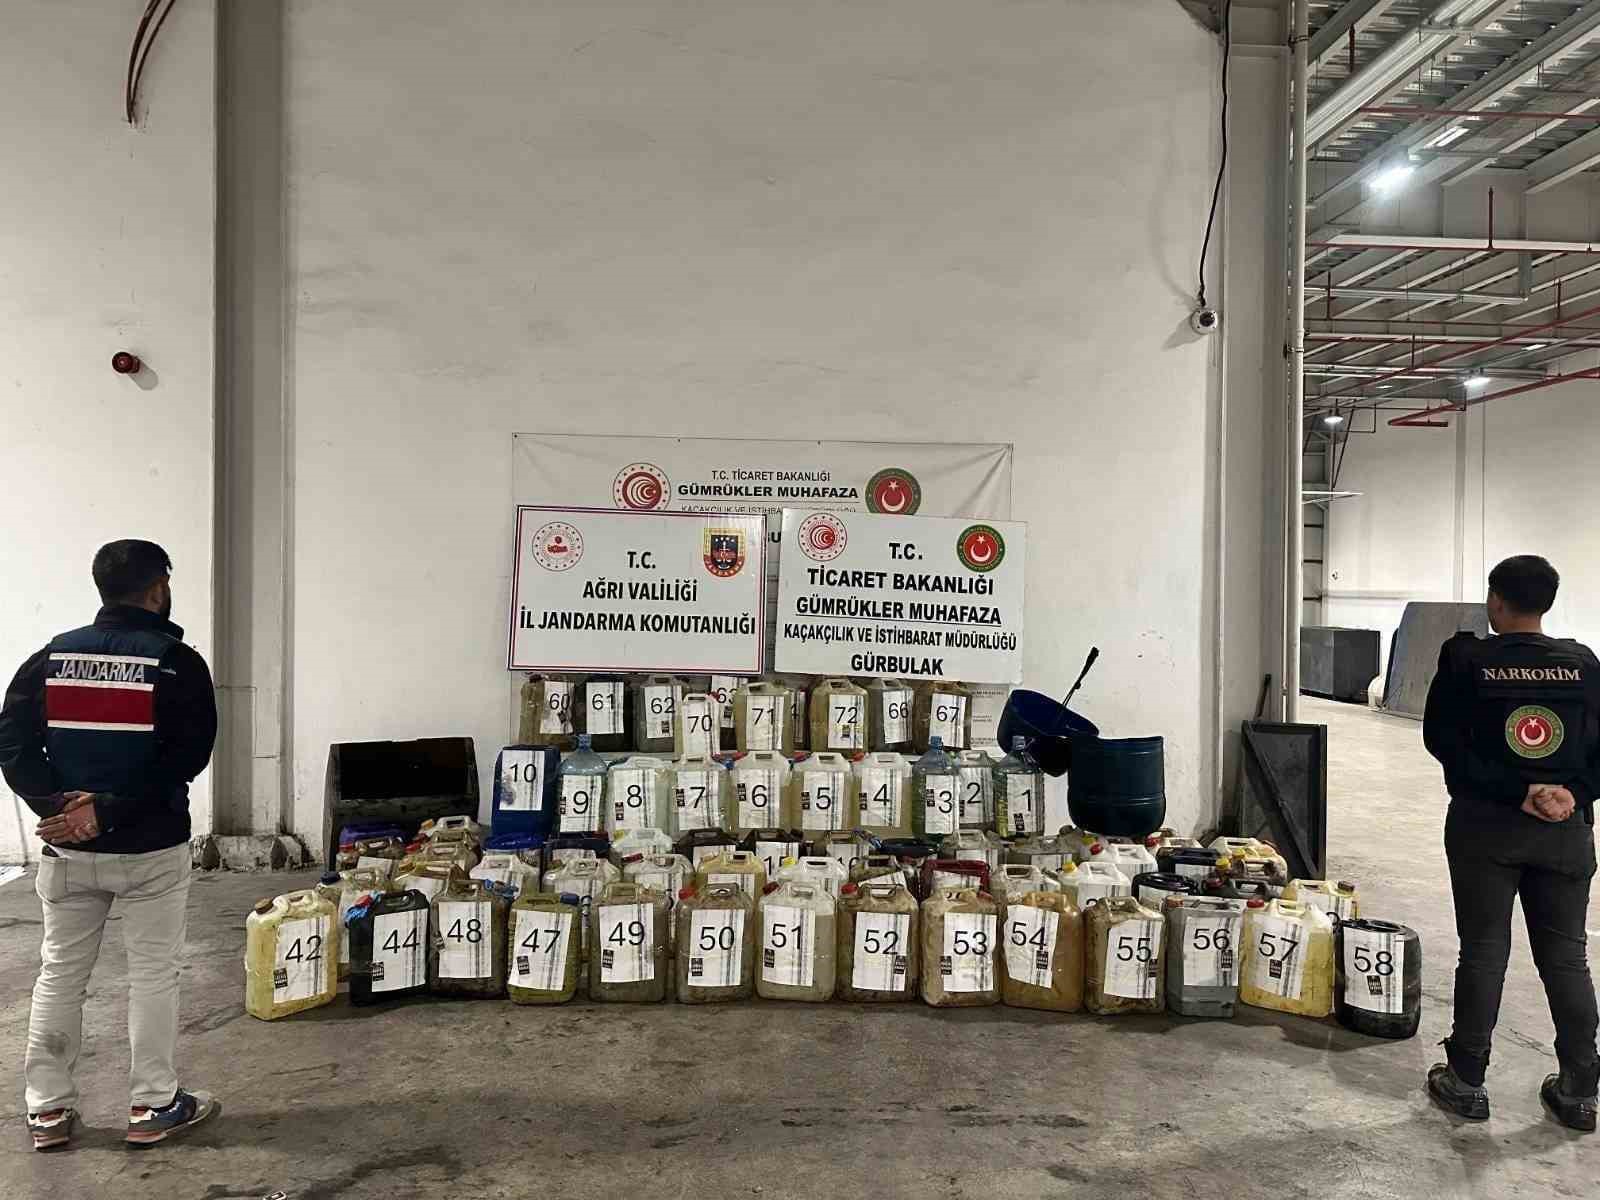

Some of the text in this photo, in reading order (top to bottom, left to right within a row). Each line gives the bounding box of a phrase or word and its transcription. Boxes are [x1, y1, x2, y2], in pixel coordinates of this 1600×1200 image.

[711, 468, 831, 483] T.C. TİCARET BAKANLIĞI
[678, 482, 858, 499] GÜMRÜKLER MUHAFAZA
[627, 551, 656, 569] T.C.
[889, 542, 923, 560] T.C.
[583, 577, 697, 602] AĞRI VALİLİĞİ
[808, 565, 993, 595] TİCARET BAKANLIĞI
[520, 606, 755, 635] İL JANDARMA KOMUTANLIĞI
[796, 594, 1001, 624] GÜMRÜKLER MUHAFAZA
[784, 623, 1016, 651] KAÇAKÇILIK VE İSTİHBARAT MÜDÜRLÜĞÜ
[56, 661, 145, 682] JANDARMA
[851, 651, 944, 675] GÜRBULAK
[1482, 666, 1581, 681] NARKOKİM
[550, 693, 570, 710] 60
[592, 694, 614, 711] 61
[651, 697, 675, 714] 62
[888, 702, 909, 719] 66
[688, 715, 712, 733] 70
[752, 708, 774, 725] 71
[834, 707, 858, 724] 72
[936, 705, 959, 722] 67
[510, 763, 537, 783] 10
[573, 791, 589, 814] 9
[627, 784, 642, 808] 8
[690, 787, 706, 808] 7
[752, 785, 767, 807] 6
[816, 787, 831, 809] 5
[873, 784, 890, 806] 4
[938, 791, 953, 814] 3
[966, 782, 981, 804] 2
[1021, 789, 1031, 811] 1
[382, 928, 420, 954] 44
[447, 918, 482, 943] 48
[521, 928, 561, 955] 47
[608, 921, 645, 946] 49
[699, 926, 735, 951] 50
[771, 923, 801, 949] 51
[1011, 922, 1046, 947] 54
[1193, 928, 1230, 951] 56
[285, 935, 322, 963] 42
[864, 930, 899, 955] 52
[953, 930, 988, 956] 53
[1116, 937, 1150, 962] 55
[1258, 933, 1299, 961] 57
[1354, 947, 1393, 976] 58
